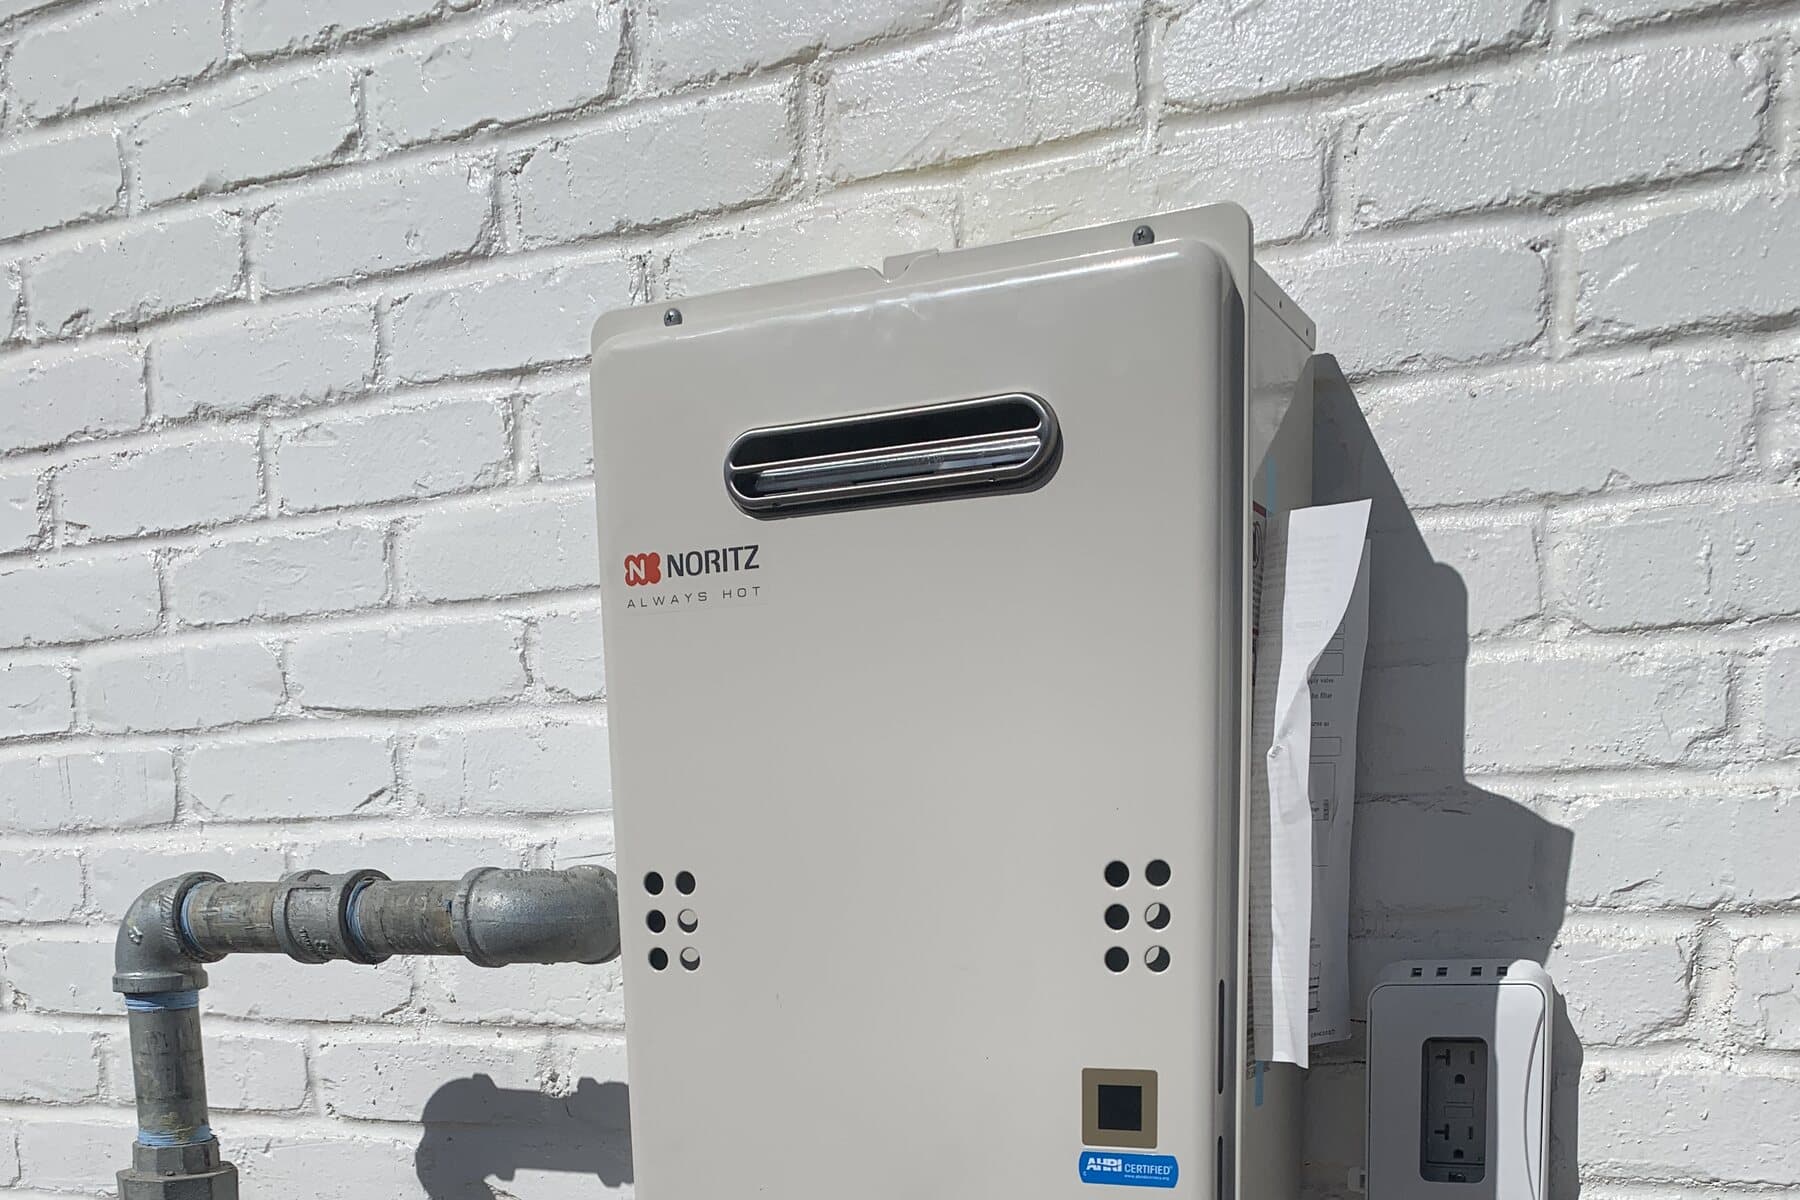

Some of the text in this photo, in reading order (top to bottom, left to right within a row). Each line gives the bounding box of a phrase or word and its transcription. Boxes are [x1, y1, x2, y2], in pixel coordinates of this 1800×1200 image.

[667, 545, 759, 578] NORITZ
[627, 586, 760, 608] ALWAYS HOT
[1086, 1158, 1170, 1175] AHRI CERTIFIED
